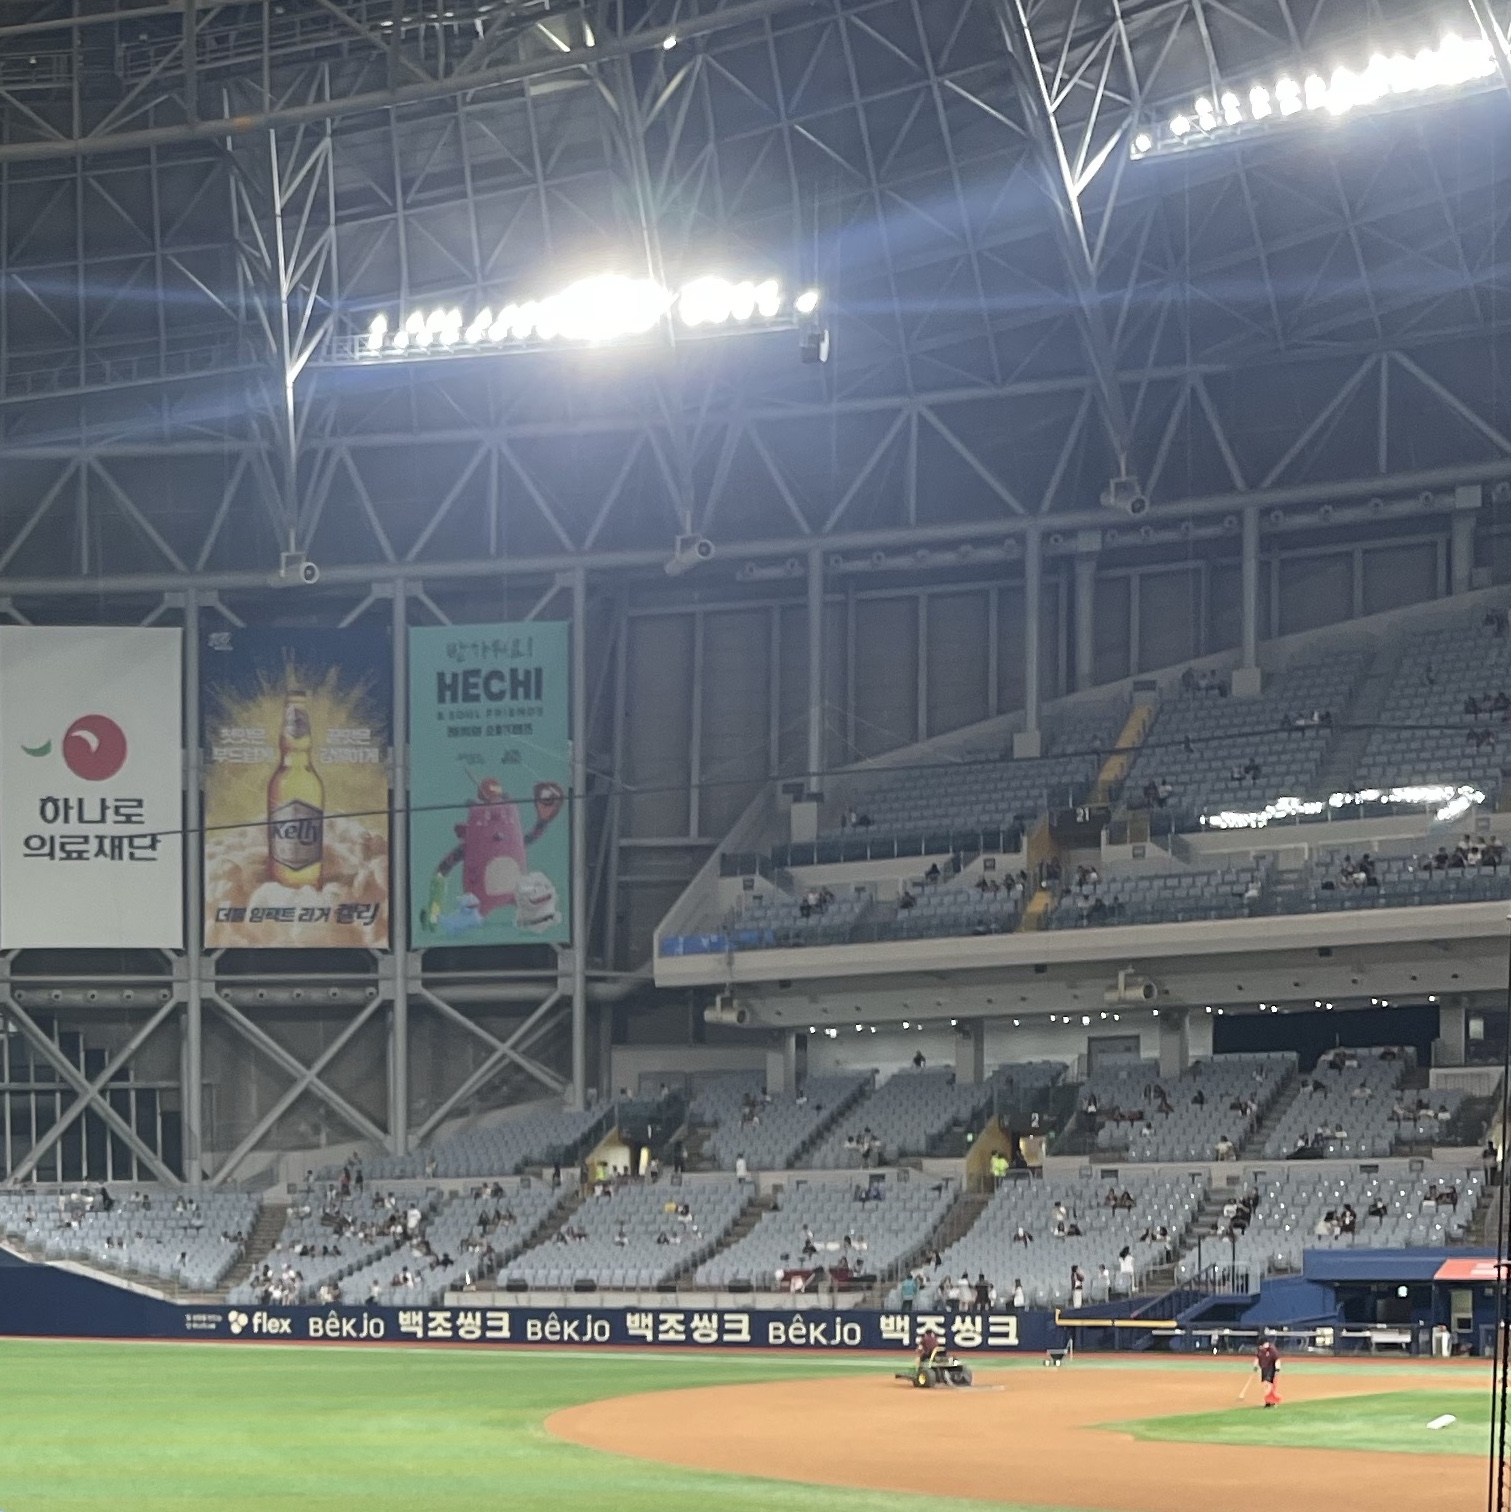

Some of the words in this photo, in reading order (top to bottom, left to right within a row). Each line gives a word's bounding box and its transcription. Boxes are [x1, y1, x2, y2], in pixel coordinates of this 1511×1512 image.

[436, 667, 543, 704] HECHI
[39, 796, 146, 825] 하나로
[23, 833, 161, 862] 의료재단
[1031, 1112, 1040, 1128] 2
[253, 1311, 293, 1334] flex
[398, 1310, 512, 1341] 백조씽크
[625, 1312, 752, 1343] 백조씽크
[879, 1313, 1020, 1347] 백조씽크
